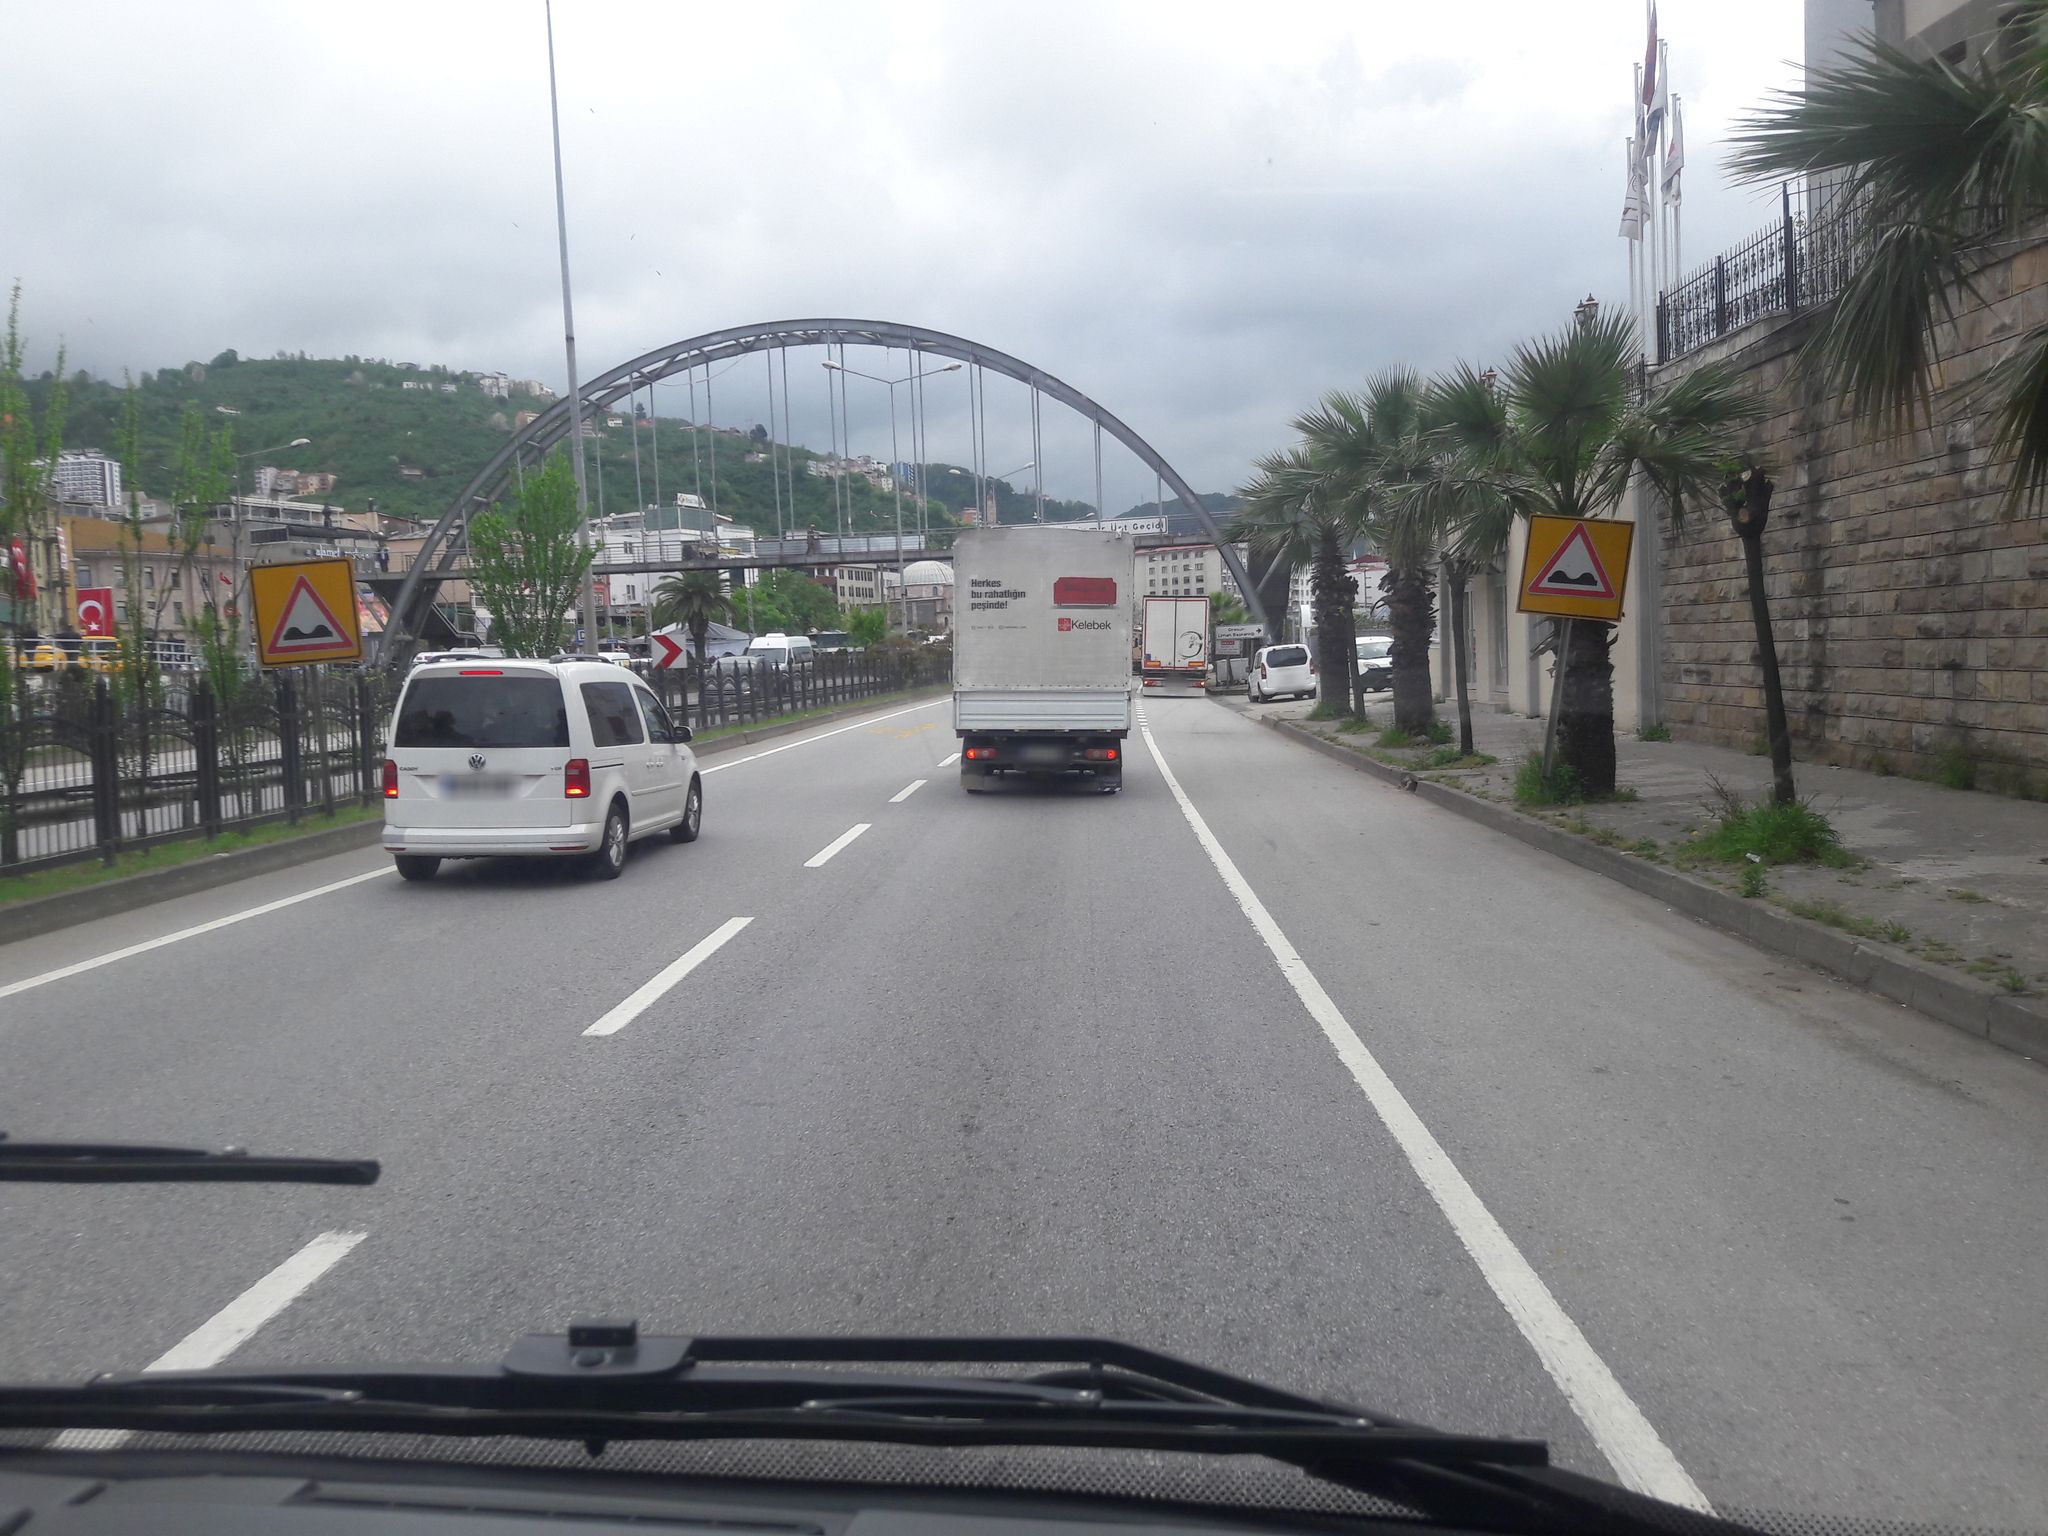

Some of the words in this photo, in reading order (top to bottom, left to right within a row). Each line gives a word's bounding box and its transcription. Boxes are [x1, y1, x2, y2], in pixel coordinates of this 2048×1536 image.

[971, 579, 1001, 588] Herkes
[971, 590, 982, 599] bu
[985, 589, 1026, 600] rahatlığın
[971, 600, 1008, 611] peşinde!
[1072, 619, 1112, 630] Kelebek
